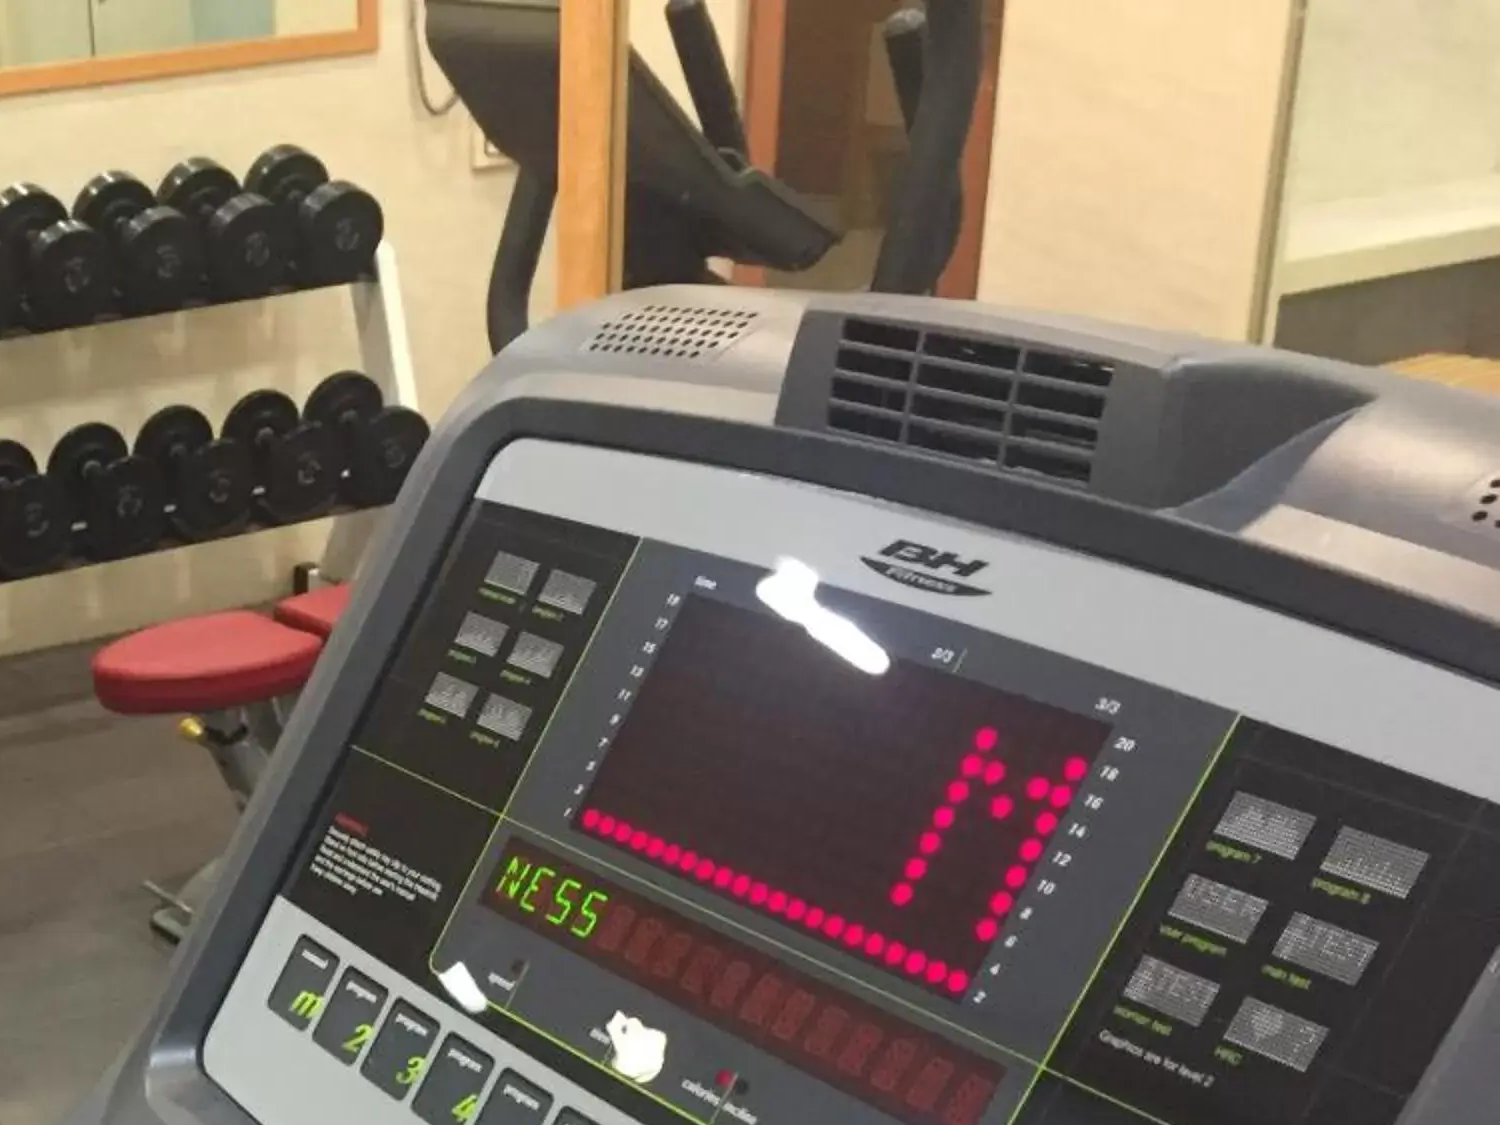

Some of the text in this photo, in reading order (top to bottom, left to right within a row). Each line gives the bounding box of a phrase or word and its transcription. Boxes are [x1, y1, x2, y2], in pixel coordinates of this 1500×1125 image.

[878, 539, 990, 576] BH
[1114, 736, 1137, 752] 20
[1100, 765, 1120, 782] 18
[1084, 794, 1104, 810] 16
[1068, 823, 1088, 838] 14
[1052, 851, 1072, 867] 12
[496, 856, 608, 937] NESS
[1037, 879, 1056, 895] 10
[289, 989, 325, 1019] m
[341, 1023, 373, 1053] 2
[395, 1056, 425, 1085] 3
[1144, 1051, 1161, 1065] are
[1164, 1056, 1179, 1071] for
[451, 1093, 479, 1123] 4
